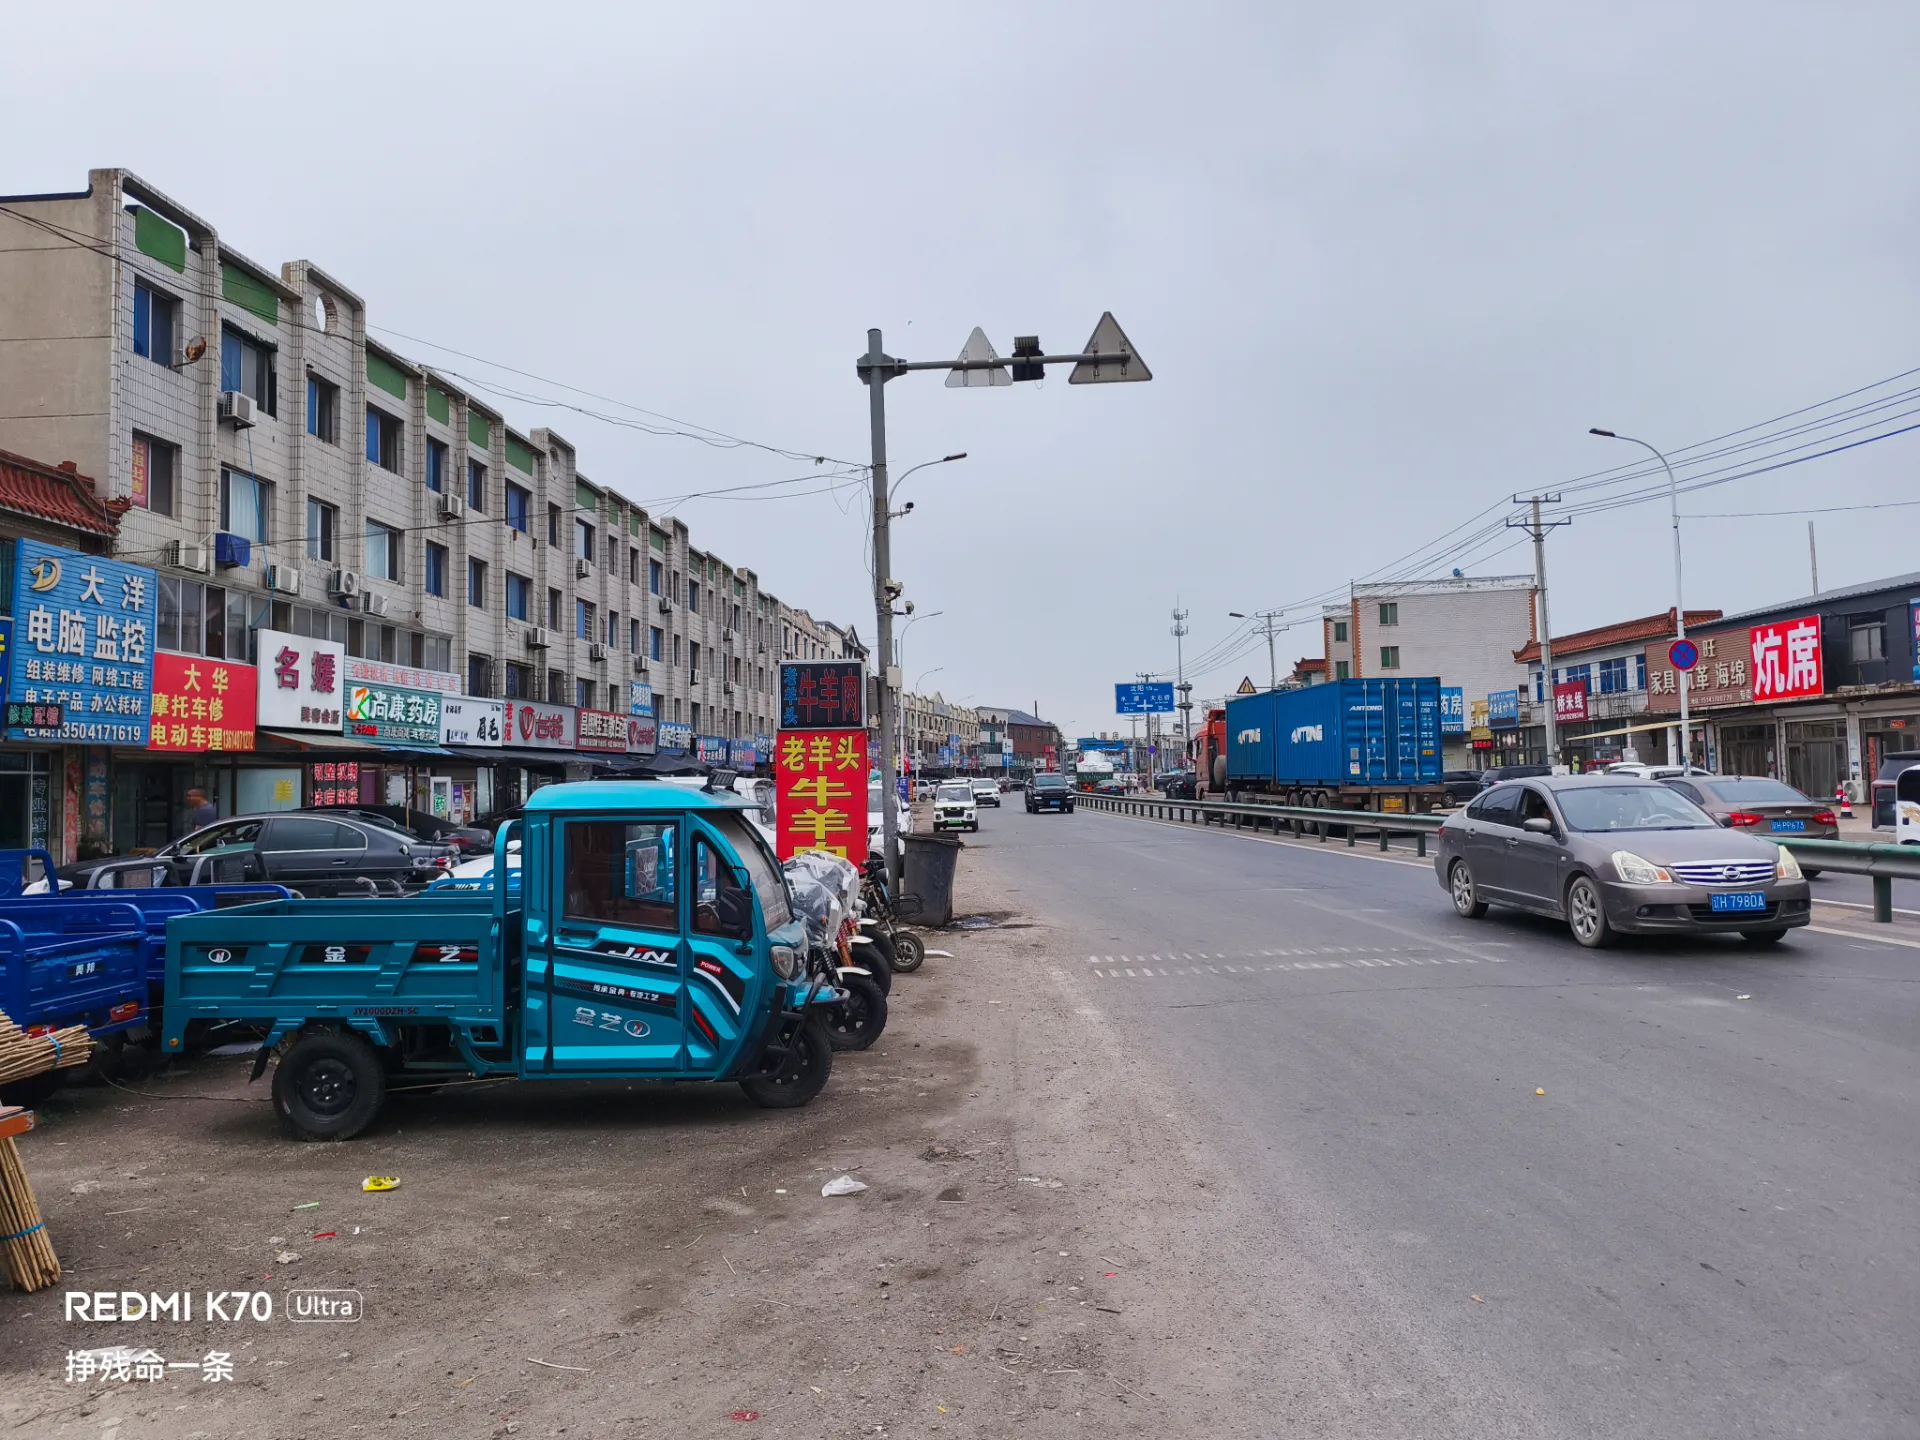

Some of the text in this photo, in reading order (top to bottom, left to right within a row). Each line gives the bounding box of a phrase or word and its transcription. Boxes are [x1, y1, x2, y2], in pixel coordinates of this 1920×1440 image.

[80, 565, 145, 612] 大洋
[28, 604, 146, 665] 电脑监控
[1702, 638, 1717, 659] 旺
[26, 658, 84, 684] 组装维修
[92, 666, 144, 690] 网络工程
[276, 645, 336, 694] 名媛
[1752, 621, 1818, 697] 炕席
[184, 663, 229, 696] 大华
[798, 667, 859, 723] 牛羊肉
[1651, 670, 1677, 696] 家具
[1715, 659, 1747, 690] 海绵
[25, 687, 143, 716] 电子产品 办公耗材
[151, 692, 223, 722] 摩托车修
[370, 691, 440, 725] 尚康药房
[783, 666, 798, 726] 老羊头
[476, 716, 500, 742] 眉毛
[503, 701, 514, 742] 老范
[781, 735, 861, 772] 老羊头
[323, 945, 461, 963] 金 艺
[700, 960, 722, 973] POWER
